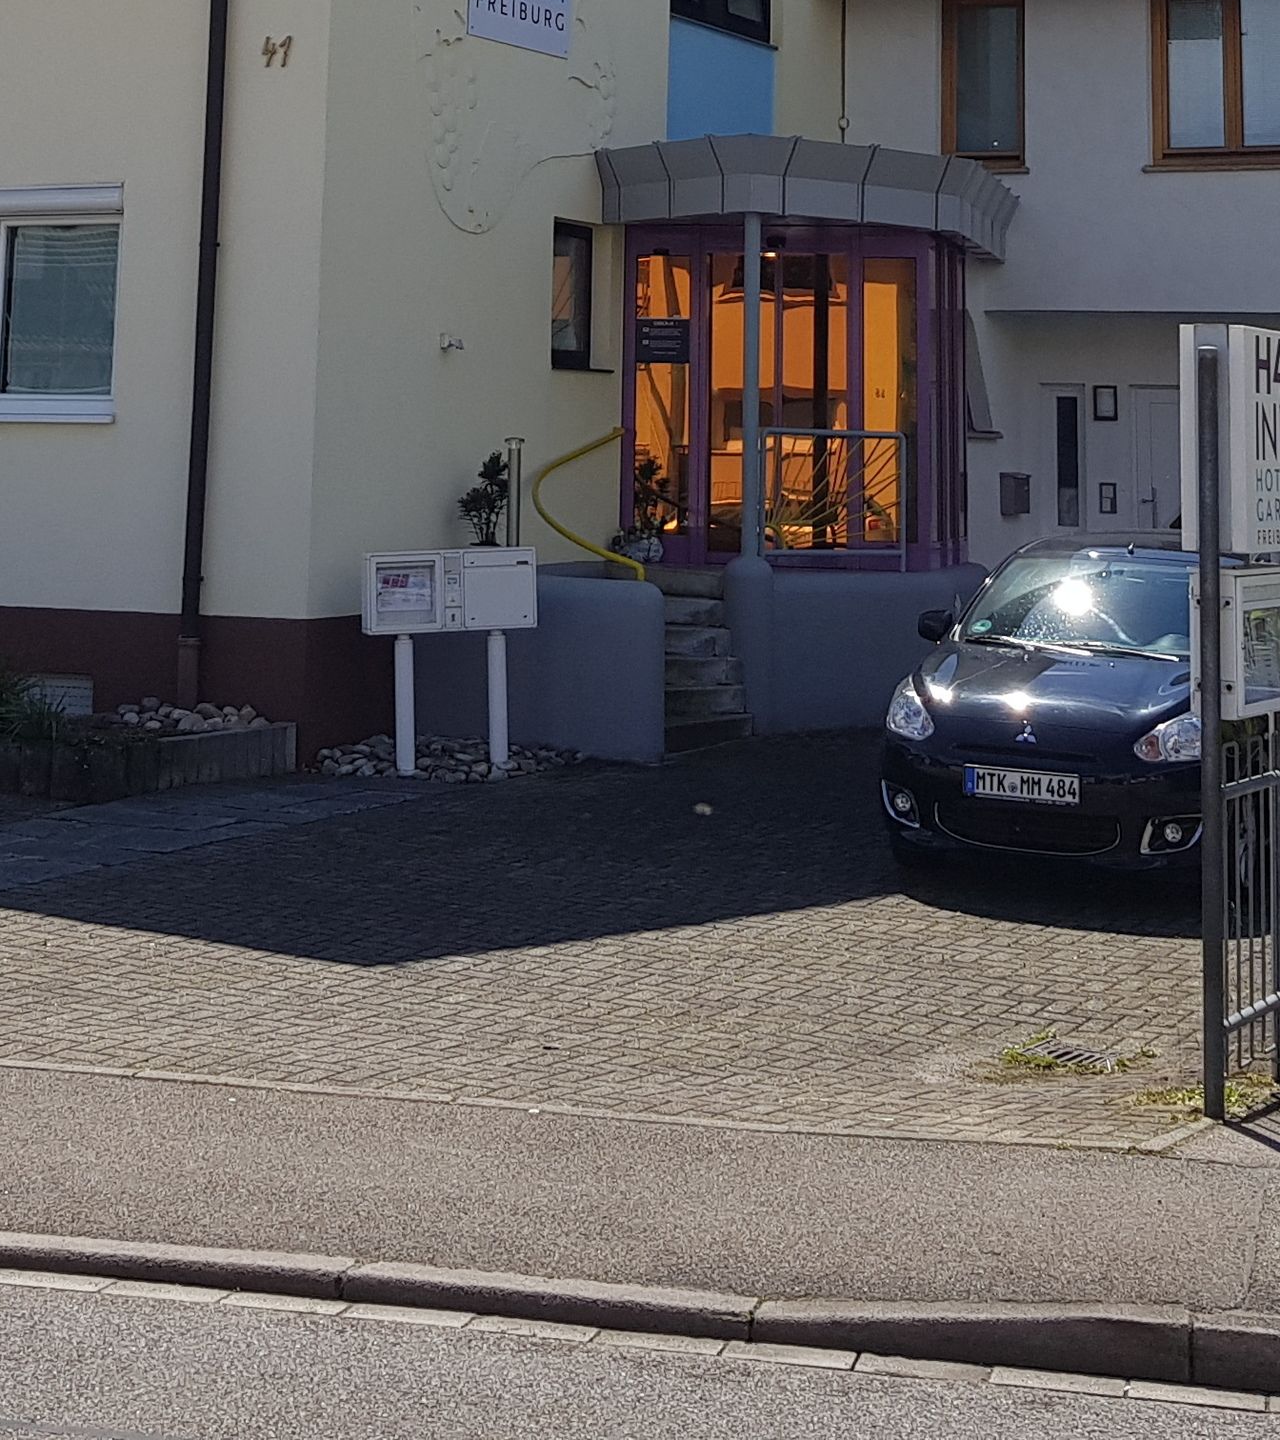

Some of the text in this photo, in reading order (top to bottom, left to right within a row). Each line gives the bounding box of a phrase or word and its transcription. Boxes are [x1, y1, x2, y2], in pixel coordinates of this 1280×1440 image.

[261, 35, 293, 68] 41
[975, 771, 1077, 799] MTK MM 484
